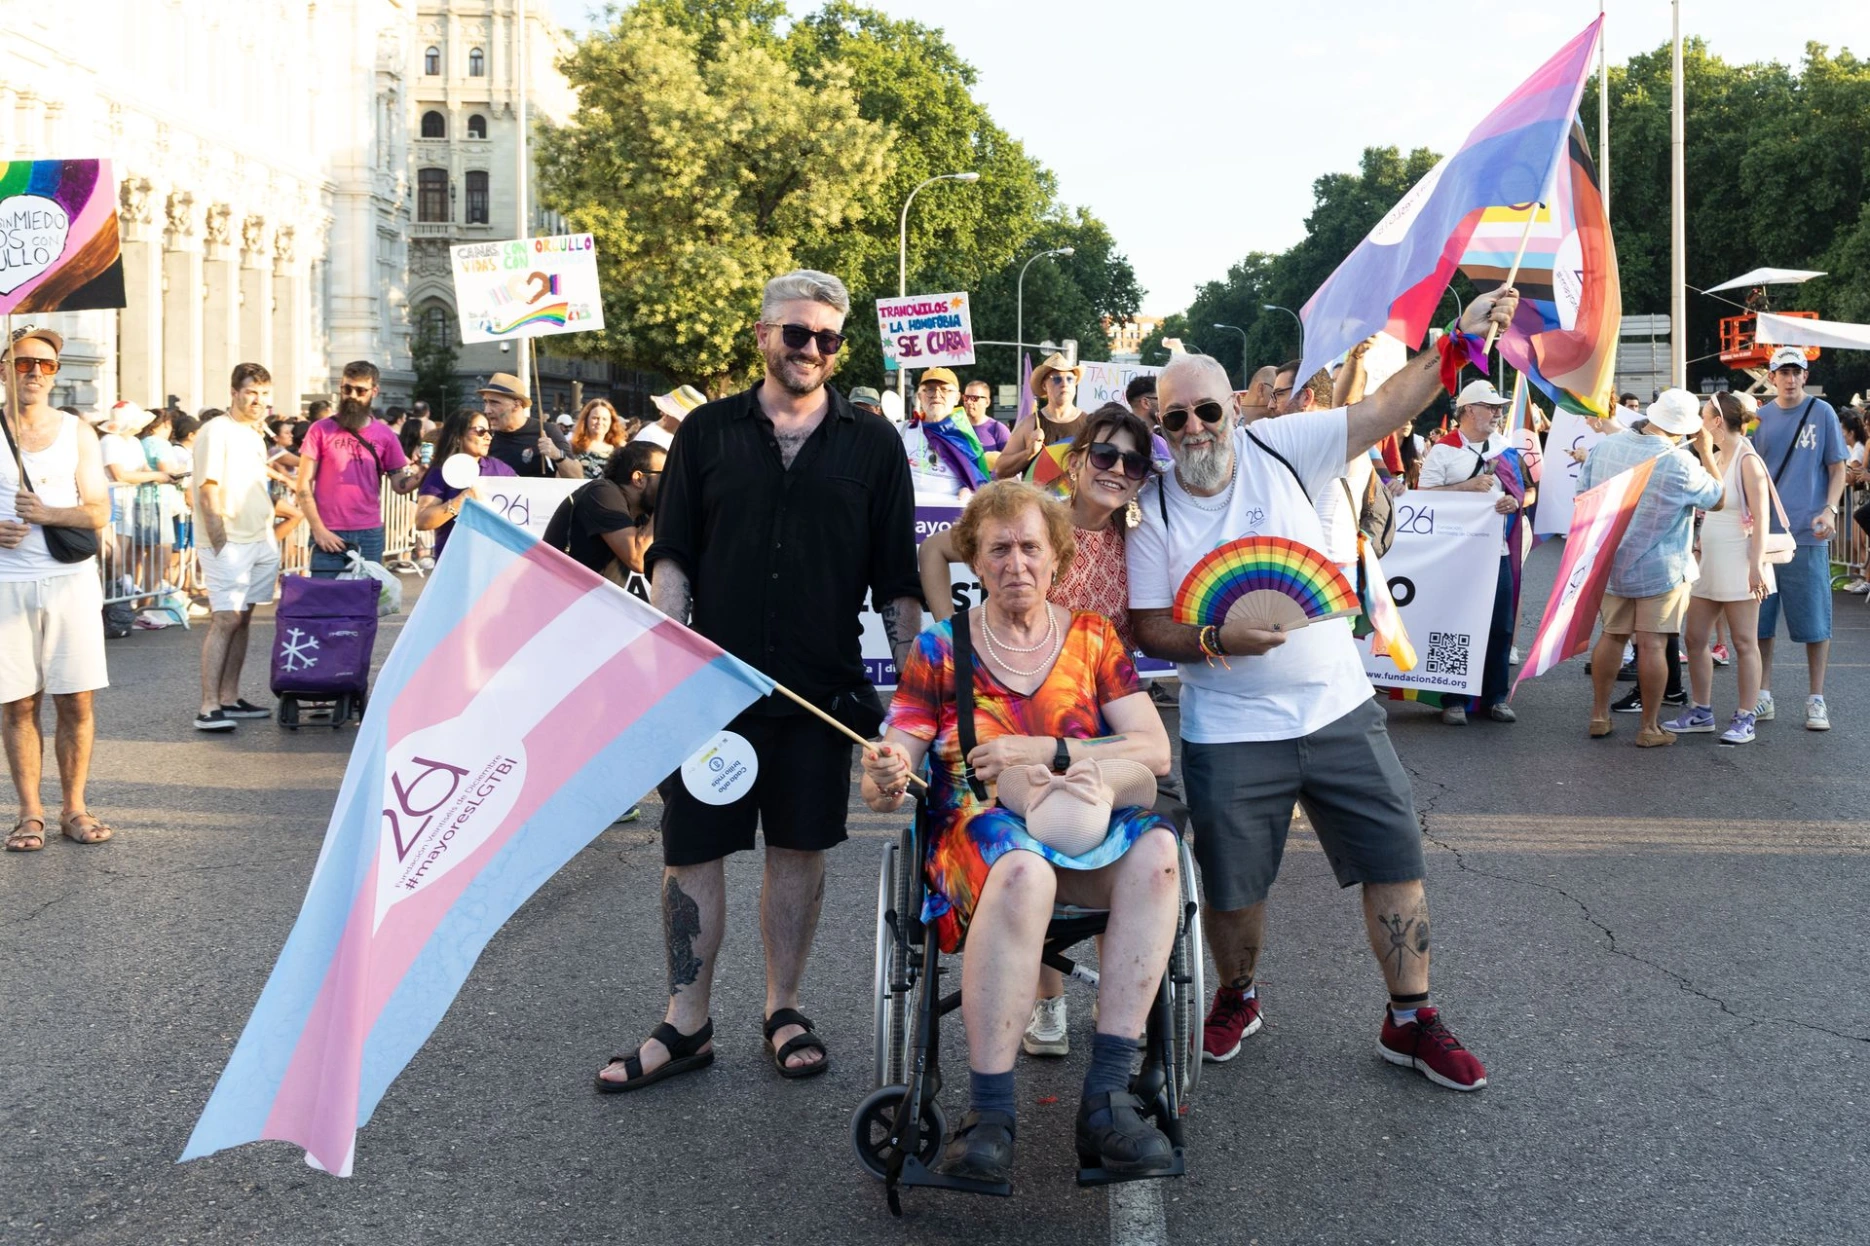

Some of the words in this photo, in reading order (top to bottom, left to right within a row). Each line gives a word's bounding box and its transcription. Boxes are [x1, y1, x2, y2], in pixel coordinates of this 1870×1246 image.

[13, 210, 66, 230] MIEDO
[31, 235, 60, 246] CON
[457, 244, 499, 259] CANAS
[503, 241, 528, 256] CON
[534, 236, 592, 253] ORGULLO
[461, 258, 497, 272] VIDAS
[502, 254, 530, 270] CON
[889, 320, 904, 334] LA
[908, 314, 962, 331] HOMOFOBIA
[897, 334, 923, 358] SE
[926, 330, 966, 355] CURA
[1094, 385, 1109, 401] NO
[1396, 505, 1435, 535] 26d
[725, 760, 741, 775] brillo
[730, 767, 747, 781] Cada
[711, 774, 725, 787] más
[718, 781, 731, 793] año
[382, 756, 470, 864] 26d
[394, 844, 429, 889] Fundación
[456, 794, 468, 807] de
[466, 754, 503, 795] Diciembre
[405, 757, 519, 891] #mayoresLGTBI
